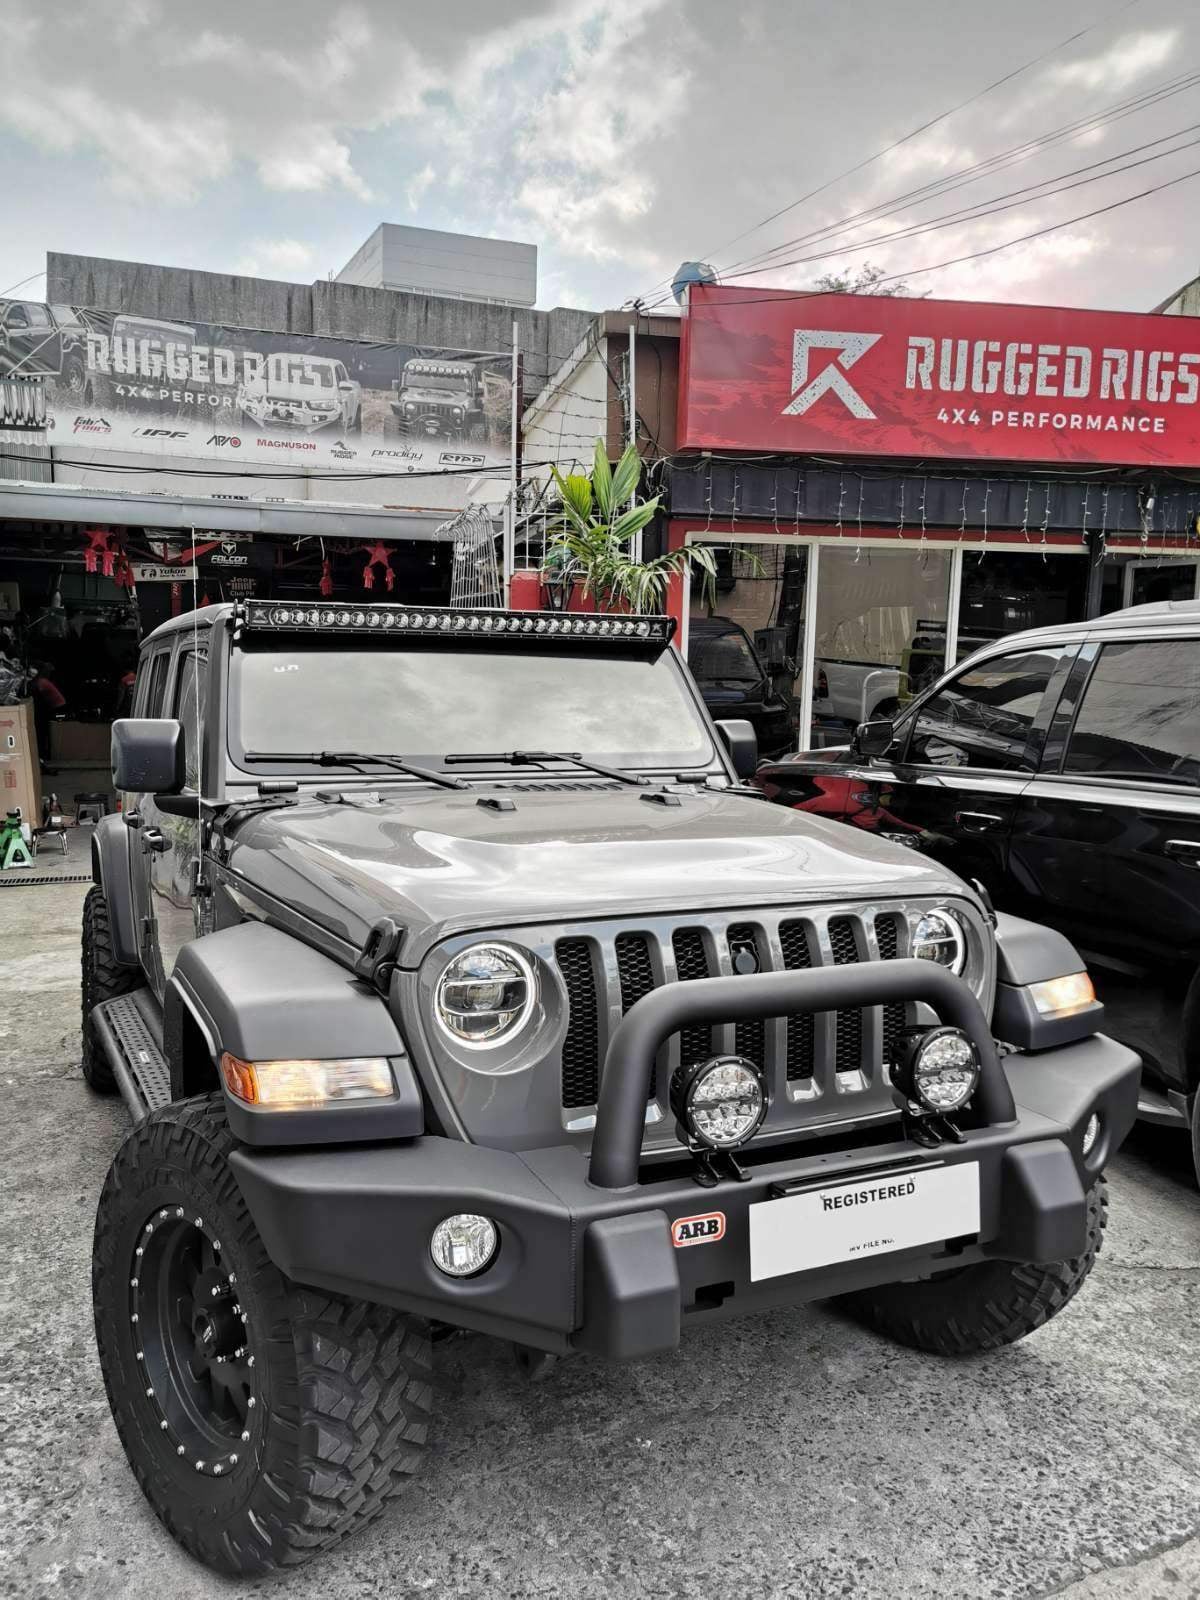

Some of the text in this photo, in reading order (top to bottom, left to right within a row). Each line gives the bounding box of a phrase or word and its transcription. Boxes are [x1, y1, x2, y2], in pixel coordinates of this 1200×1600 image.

[87, 333, 235, 385] RUGGED
[905, 336, 1200, 404] RUGGED RIGS
[142, 428, 189, 438] IPF
[937, 408, 1166, 433] 4X4 PERFORMANCE
[257, 438, 316, 450] MAGNUSON
[823, 1181, 916, 1211] REGISTERED
[678, 1219, 720, 1241] ARB
